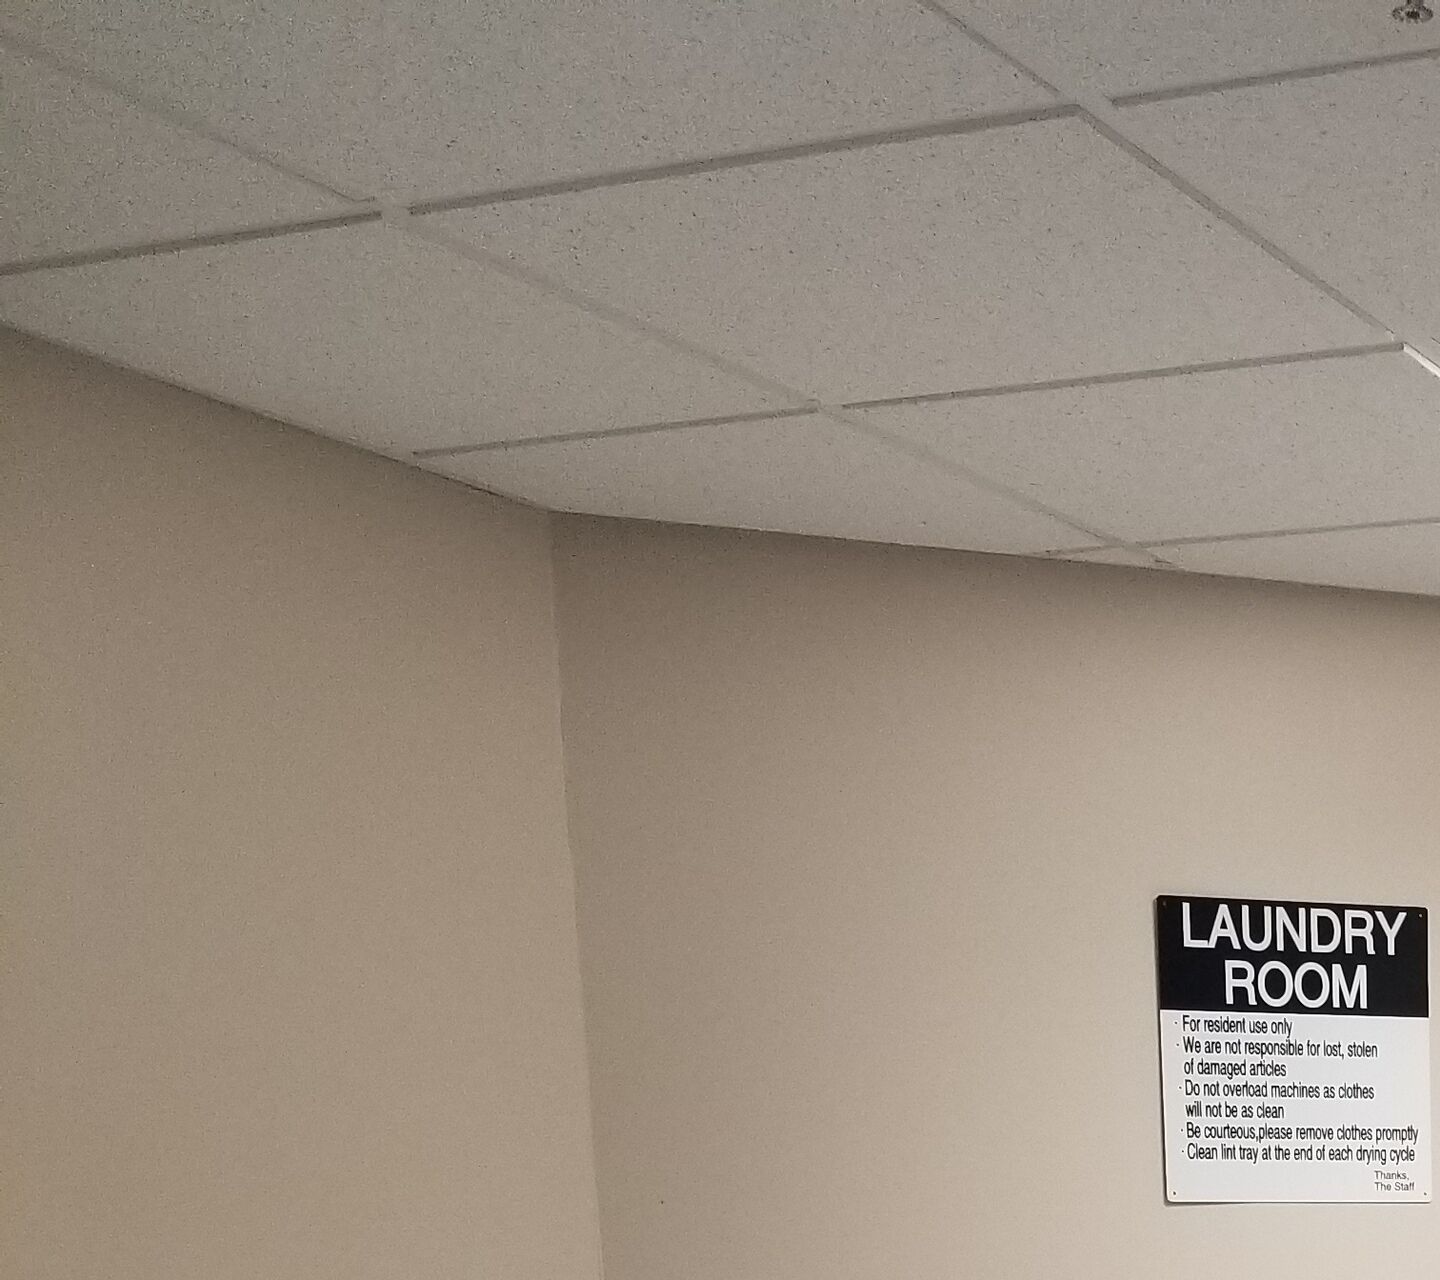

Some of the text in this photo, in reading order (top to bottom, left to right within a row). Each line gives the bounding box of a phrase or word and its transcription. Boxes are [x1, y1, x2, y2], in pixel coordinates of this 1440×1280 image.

[1181, 901, 1407, 956] LAUNDRY
[1224, 959, 1369, 1010] ROOM
[1182, 1014, 1293, 1039] For resident use only
[1182, 1036, 1378, 1060] We are not responsible for lost, stolen
[1183, 1058, 1287, 1080] of damaged articles
[1184, 1078, 1375, 1100] Do not overload machines as clothes
[1185, 1100, 1285, 1119] will not be as clean
[1186, 1121, 1201, 1139] Be
[1295, 1127, 1334, 1141] remove
[1336, 1124, 1373, 1141] clothes
[1375, 1124, 1419, 1145] promptly
[1187, 1142, 1415, 1166] Clean lint tray at the end of each drying cycle
[1374, 1170, 1410, 1181] Thanks,
[1374, 1181, 1415, 1191] The Staff
